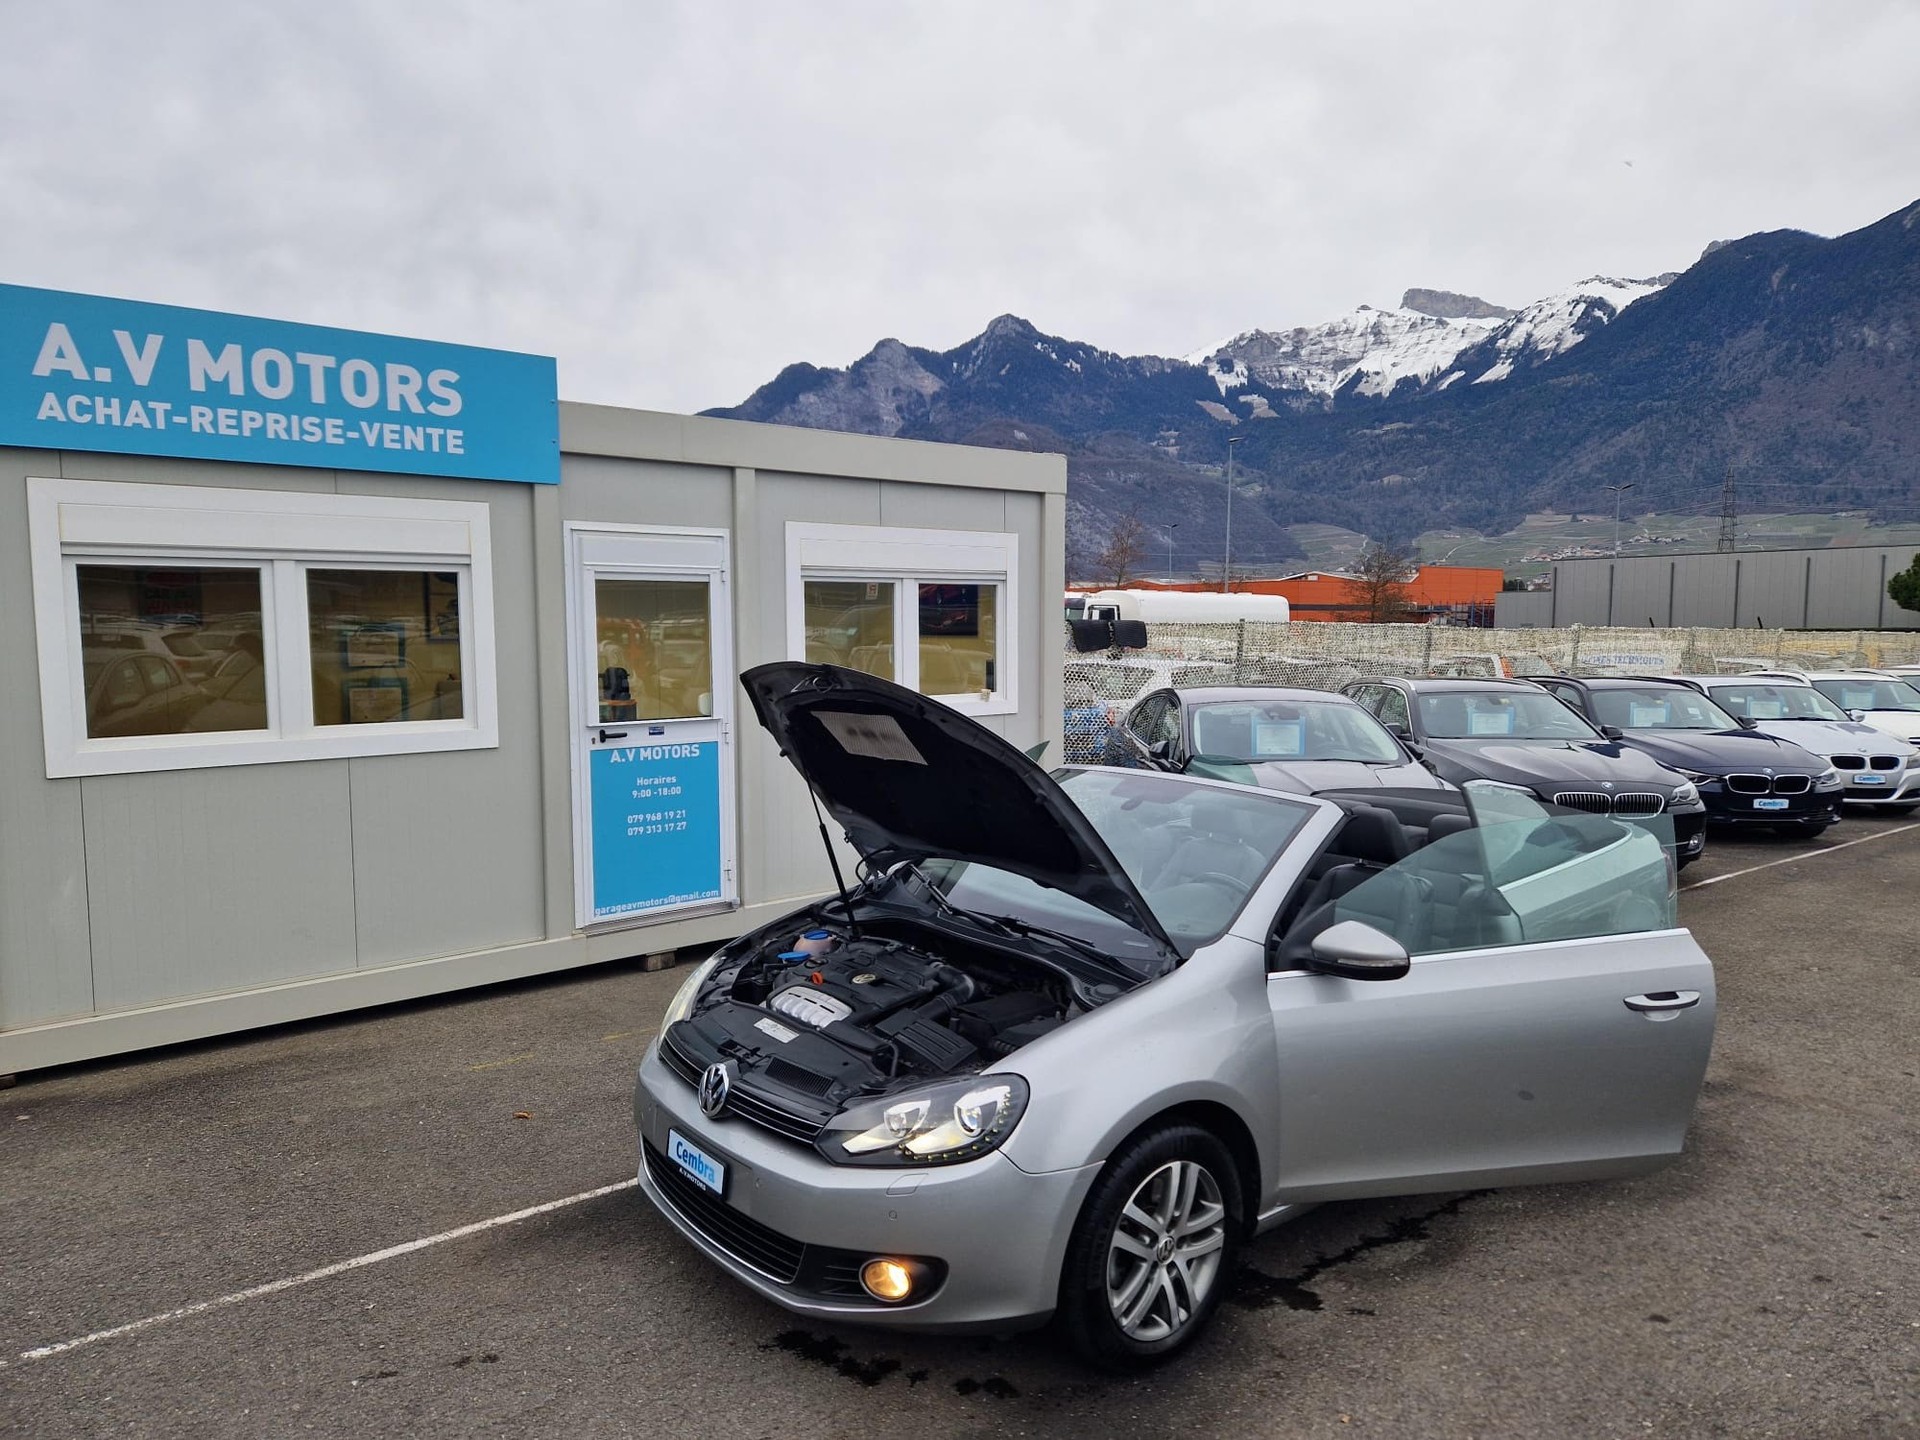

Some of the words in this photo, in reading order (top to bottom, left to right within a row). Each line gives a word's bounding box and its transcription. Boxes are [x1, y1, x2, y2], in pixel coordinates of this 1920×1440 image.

[32, 322, 163, 386] A.V
[187, 338, 463, 417] MOTORS
[37, 392, 465, 454] ACHAT-REPRISE-VENTE
[610, 749, 636, 763] A.V
[639, 744, 700, 761] MOTORS
[637, 775, 677, 786] Horaires
[632, 789, 652, 798] 9:00
[627, 815, 643, 824] 079
[645, 812, 662, 821] 968
[664, 811, 675, 820] 19
[676, 809, 686, 819] 21
[627, 826, 643, 836] 079
[646, 825, 662, 834] 313
[664, 823, 675, 832] 17
[676, 821, 687, 830] 27
[594, 889, 719, 915] garageavmotors@gmail.com
[676, 1141, 715, 1184] Cembra
